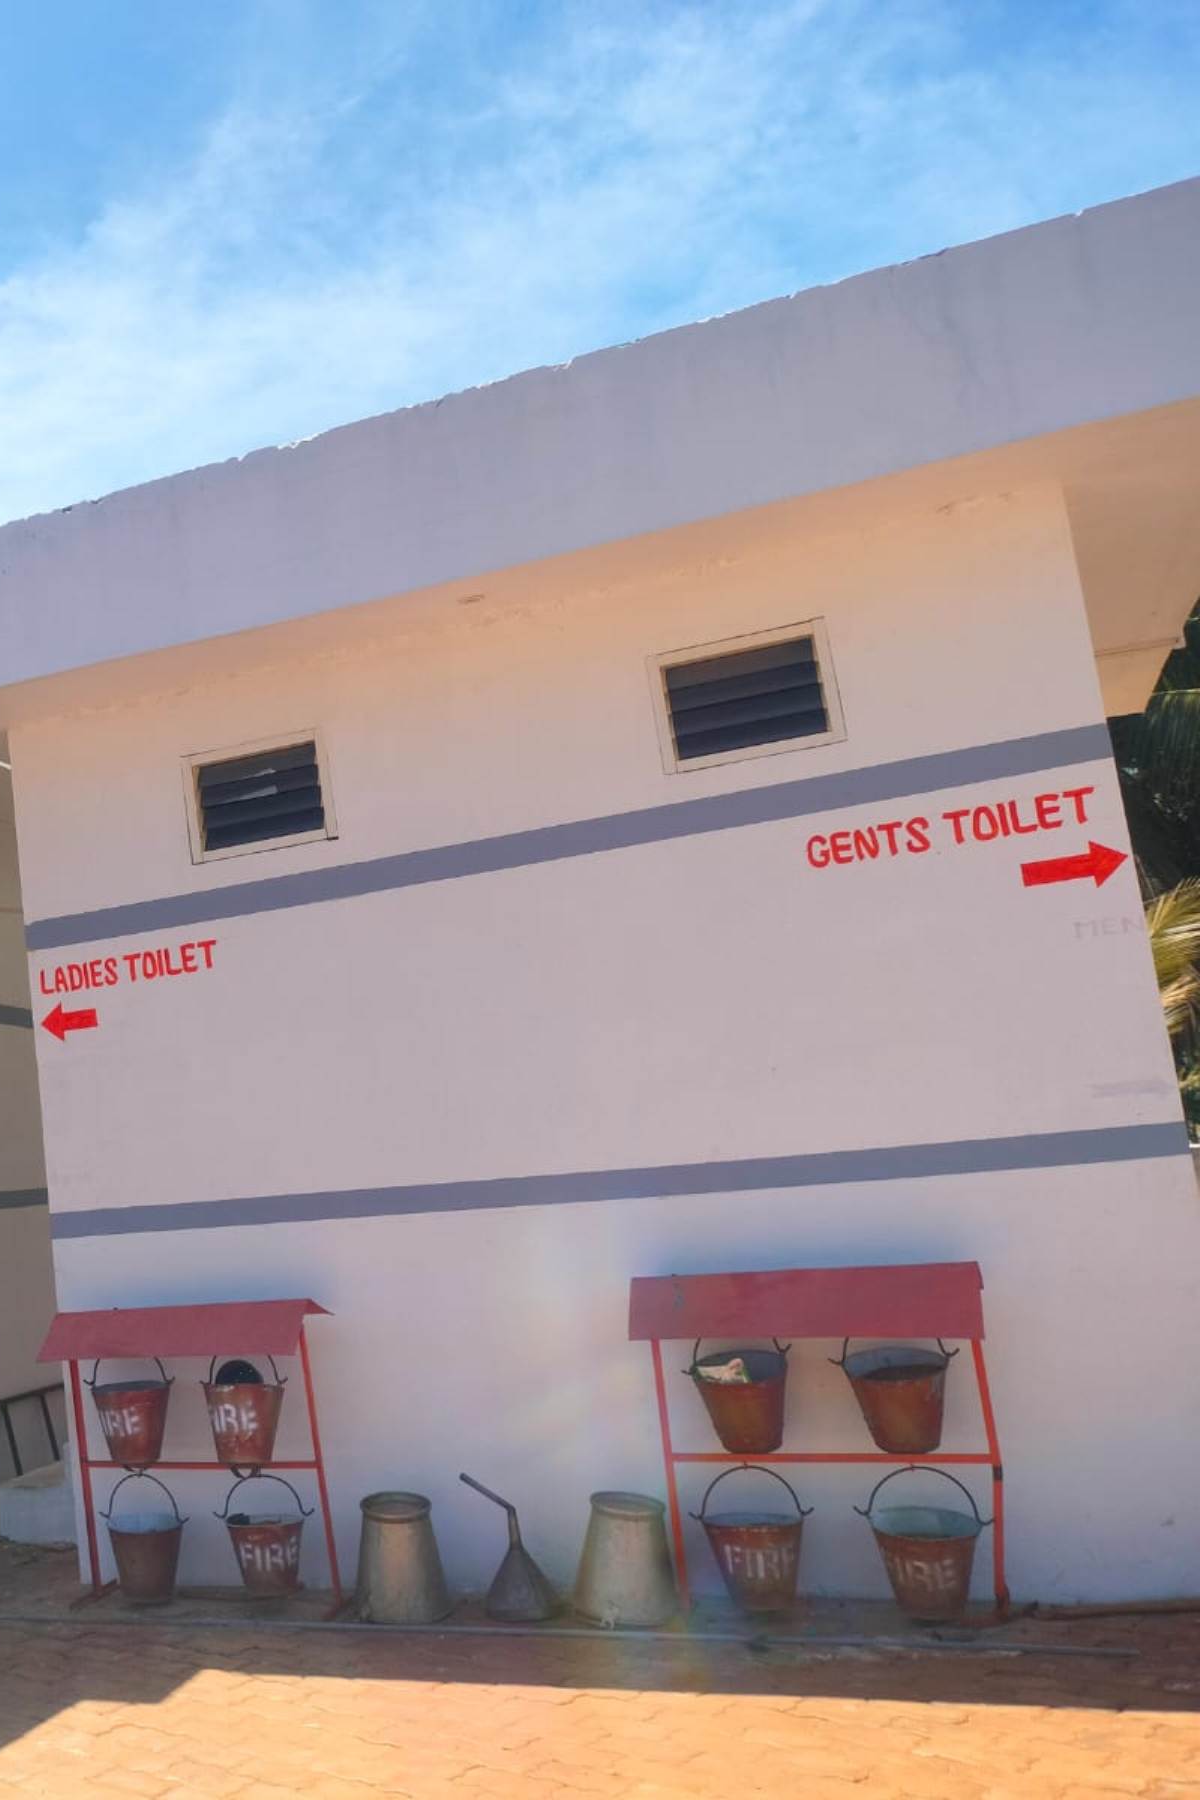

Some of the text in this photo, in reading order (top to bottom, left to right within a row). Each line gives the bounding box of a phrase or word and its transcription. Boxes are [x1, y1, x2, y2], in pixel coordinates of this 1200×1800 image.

[806, 786, 1095, 868] GENTS TOILET
[40, 939, 217, 995] LADIES TOILET
[102, 1405, 141, 1437] IRE
[210, 1401, 258, 1440] IRE
[890, 1557, 957, 1592] IRE
